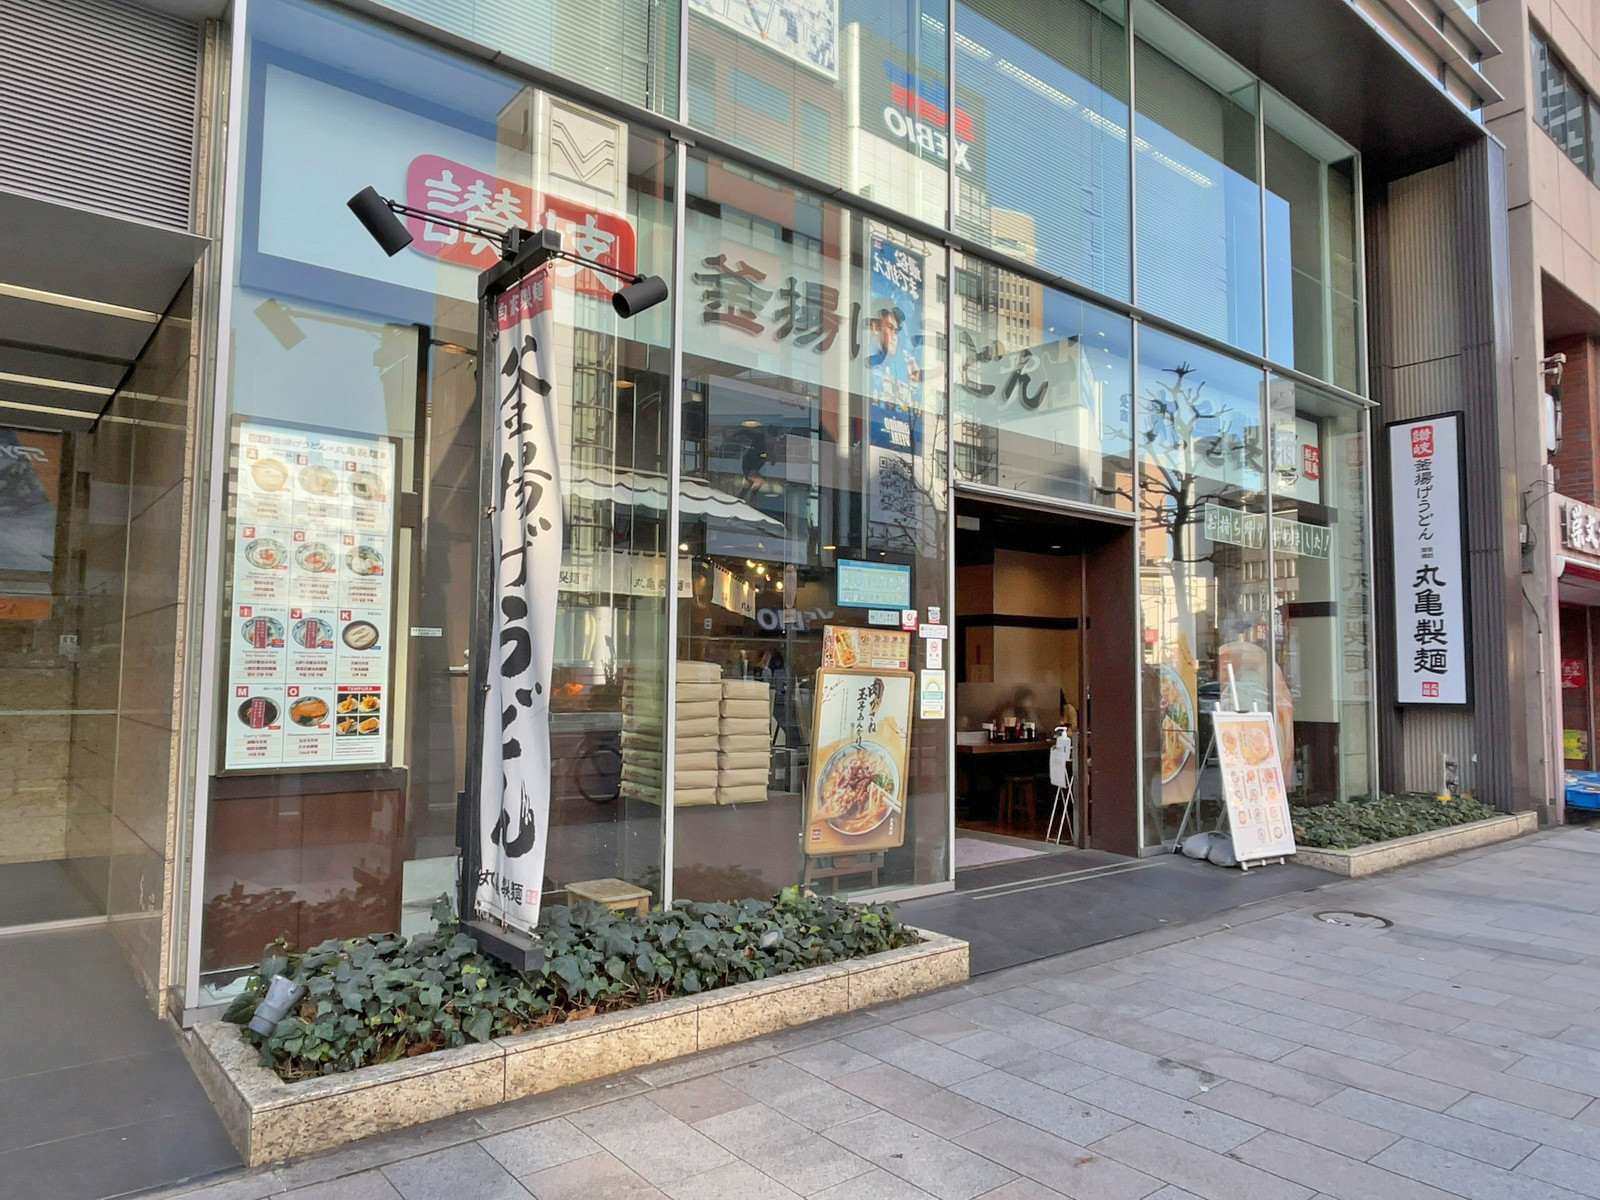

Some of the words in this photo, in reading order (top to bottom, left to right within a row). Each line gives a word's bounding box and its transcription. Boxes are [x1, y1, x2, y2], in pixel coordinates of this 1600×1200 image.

[1412, 428, 1433, 455] 讃岐
[1414, 458, 1434, 541] 釜揚げうどん
[1412, 563, 1448, 675] 丸亀製麺
